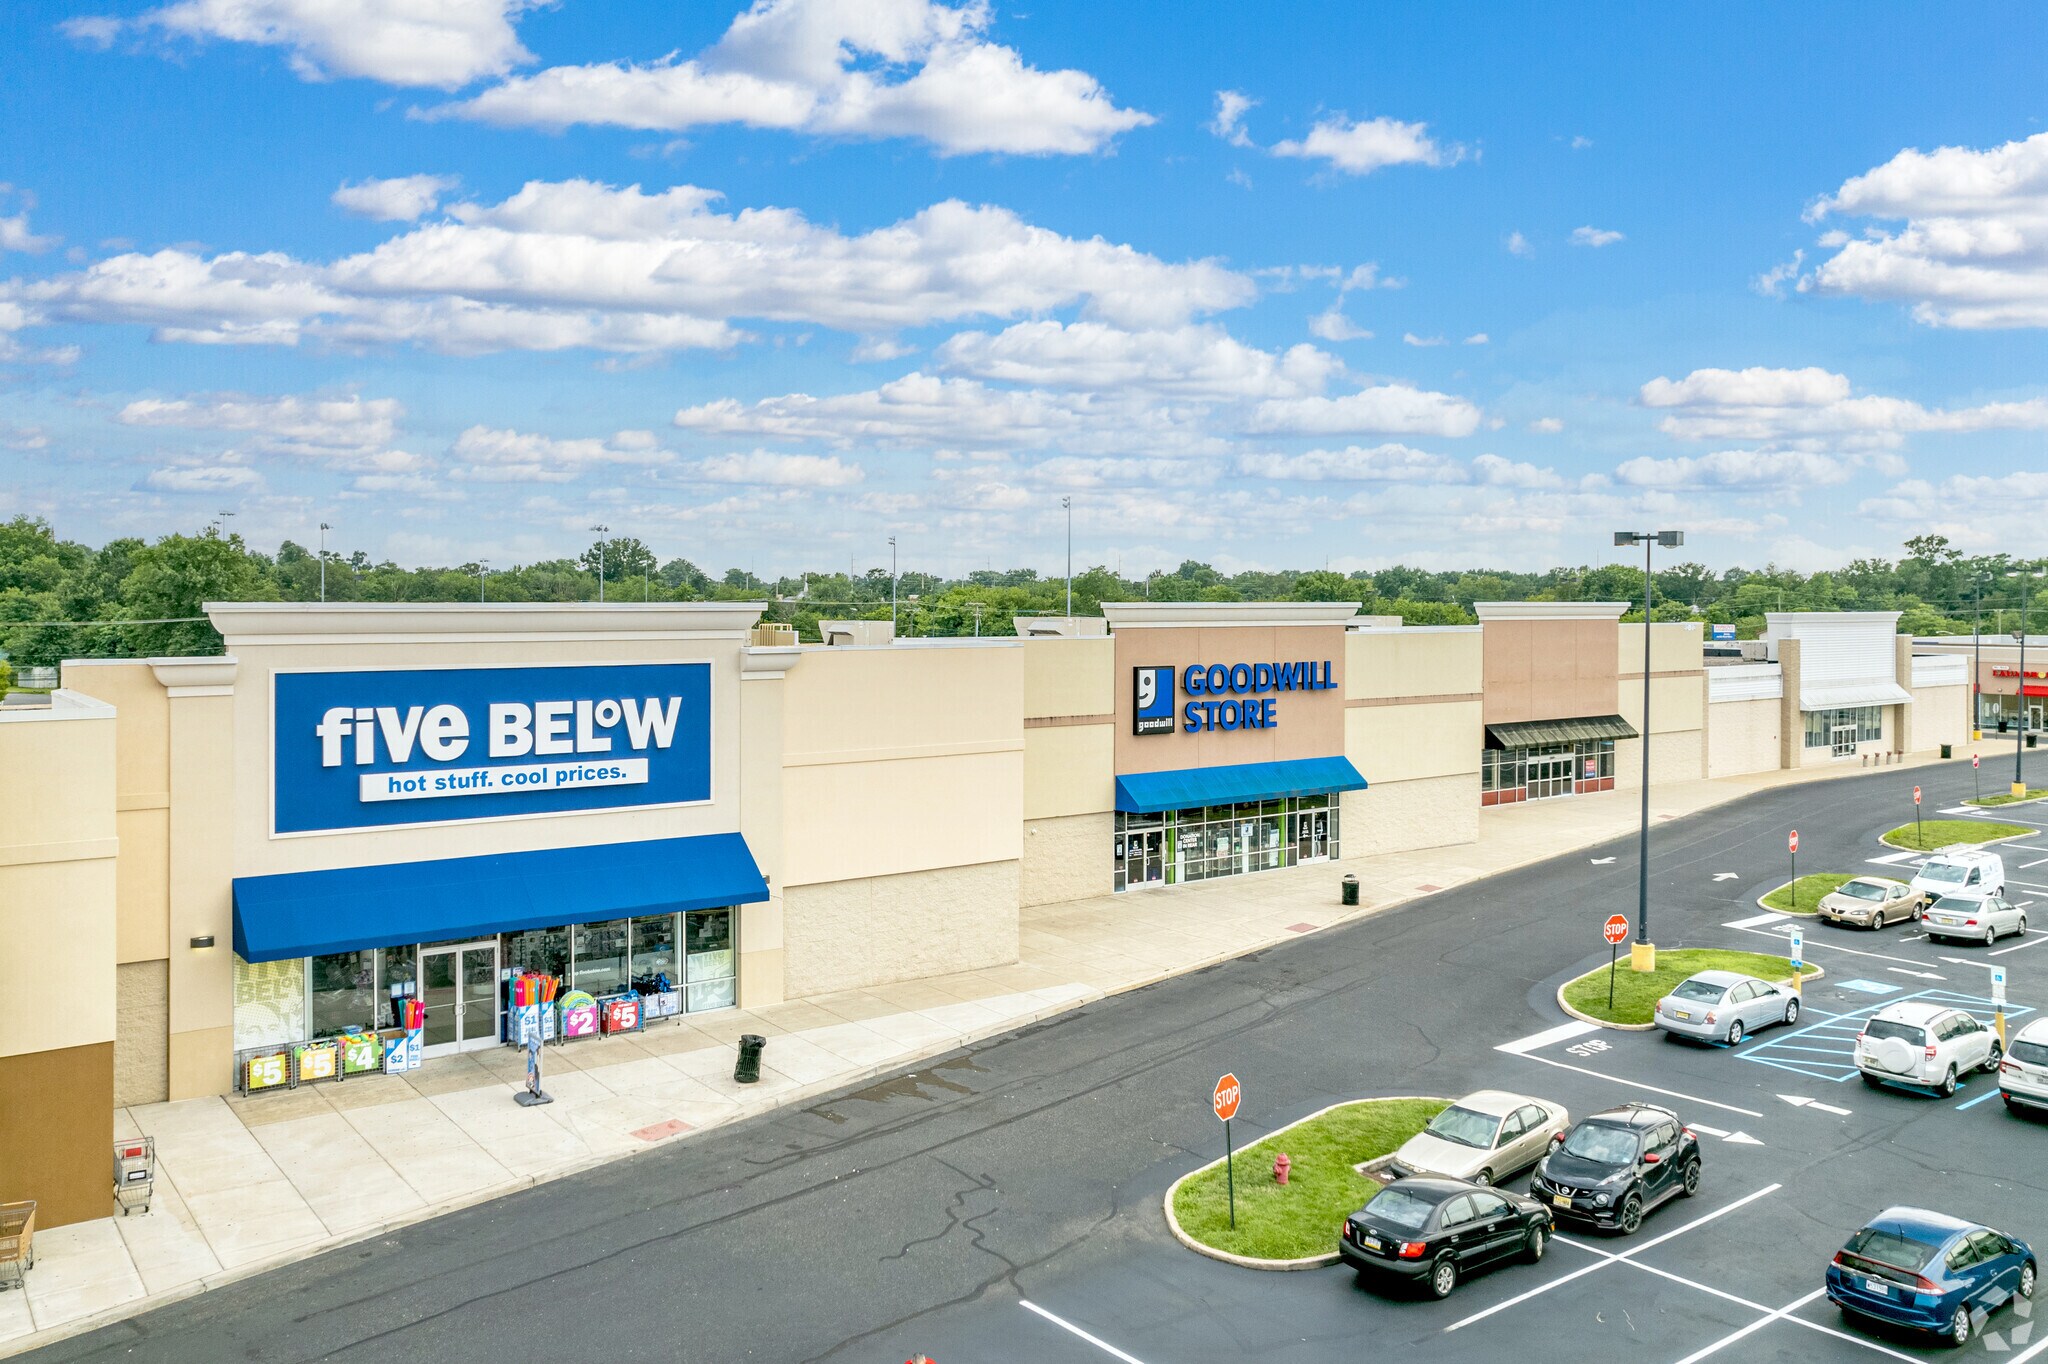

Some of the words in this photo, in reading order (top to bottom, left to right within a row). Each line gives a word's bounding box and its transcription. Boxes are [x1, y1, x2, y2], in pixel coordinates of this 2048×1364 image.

[1184, 661, 1338, 697] GOODWILL
[1138, 717, 1173, 733] goodwill
[1184, 698, 1278, 733] STORE
[315, 703, 470, 768] five
[488, 696, 683, 759] BELOW
[388, 776, 427, 794] hot
[434, 770, 494, 791] stuff.
[501, 768, 548, 787] cool
[555, 763, 627, 789] prices.
[1605, 923, 1627, 936] STOP
[524, 1015, 537, 1026] $1
[569, 1012, 594, 1035] $2
[612, 1006, 636, 1028] $5
[347, 1045, 375, 1070] $4
[390, 1054, 404, 1065] $2
[409, 1044, 420, 1052] $1
[1565, 1039, 1613, 1057] STOP
[252, 1060, 282, 1085] $5
[303, 1053, 334, 1077] $5
[1216, 1085, 1239, 1110] STOP
